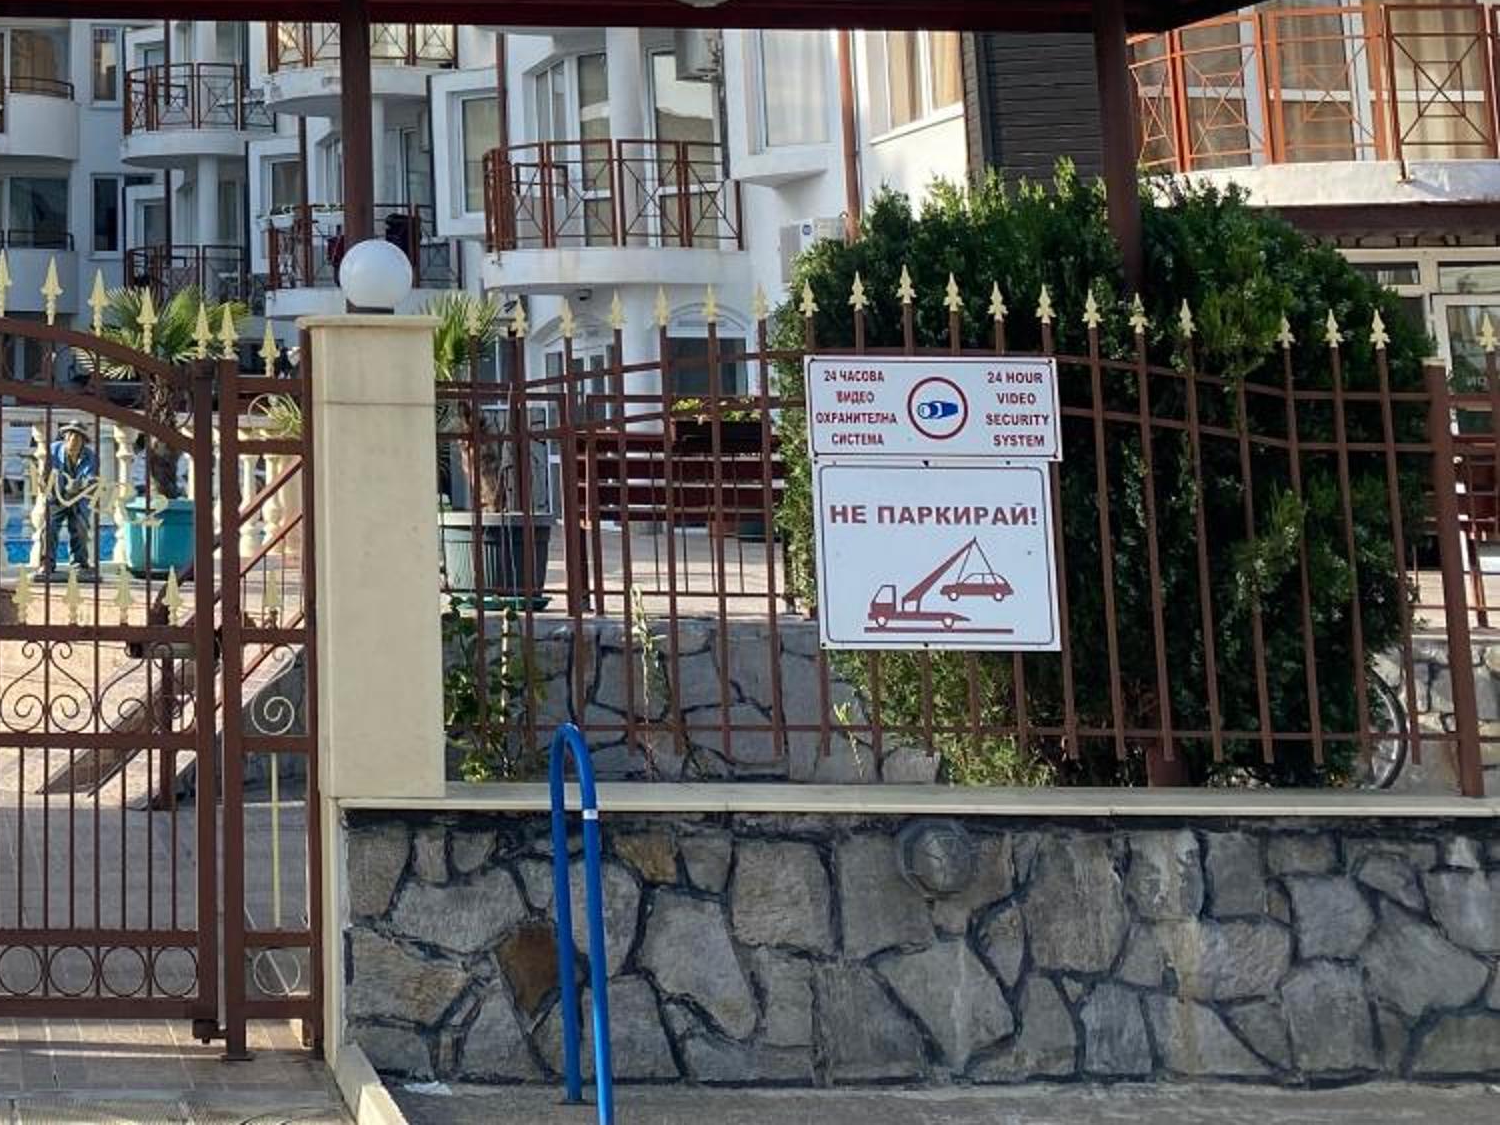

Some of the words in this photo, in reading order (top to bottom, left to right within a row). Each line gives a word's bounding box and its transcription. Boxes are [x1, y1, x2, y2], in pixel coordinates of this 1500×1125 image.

[823, 370, 837, 382] 24
[839, 370, 885, 383] ЧАСОВА
[987, 371, 1003, 384] 24
[1005, 372, 1043, 384] HOUR
[835, 390, 875, 405] ВИДЕО
[996, 392, 1037, 405] VIDEO
[815, 411, 898, 425] ОХРАНИТЕЛНА
[985, 413, 1051, 426] SECURITY
[831, 432, 885, 446] СИСТЕМА
[992, 434, 1045, 447] SYSTEM
[829, 504, 868, 524] НЕ
[877, 502, 1038, 526] ПАРКИРАЙ!
